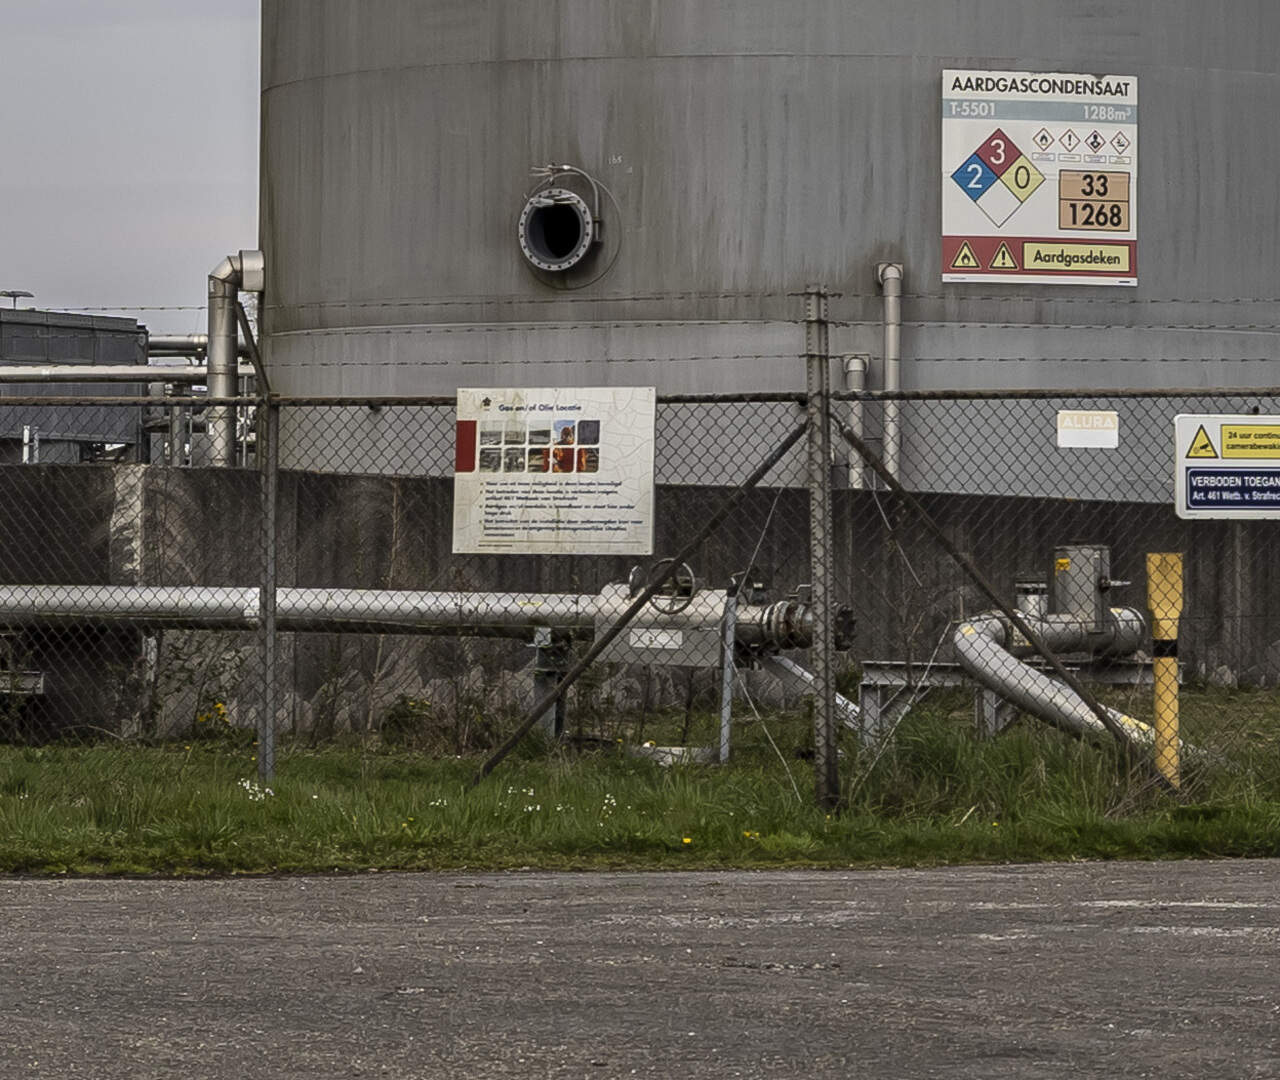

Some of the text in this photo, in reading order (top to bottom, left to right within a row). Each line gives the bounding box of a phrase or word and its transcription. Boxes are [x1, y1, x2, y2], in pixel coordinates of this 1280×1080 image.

[951, 77, 1130, 97] AARDGASCONDENSAAT
[950, 102, 996, 116] T-5501
[990, 139, 1005, 164] 3
[967, 164, 982, 188] 2
[1014, 165, 1030, 189] 0
[1081, 174, 1108, 196] 33
[1070, 203, 1122, 227] 1268
[1033, 249, 1121, 267] Aardgasdeken
[1063, 415, 1115, 428] ALURA
[1228, 431, 1238, 440] 24
[1191, 476, 1242, 487] VERBODEN
